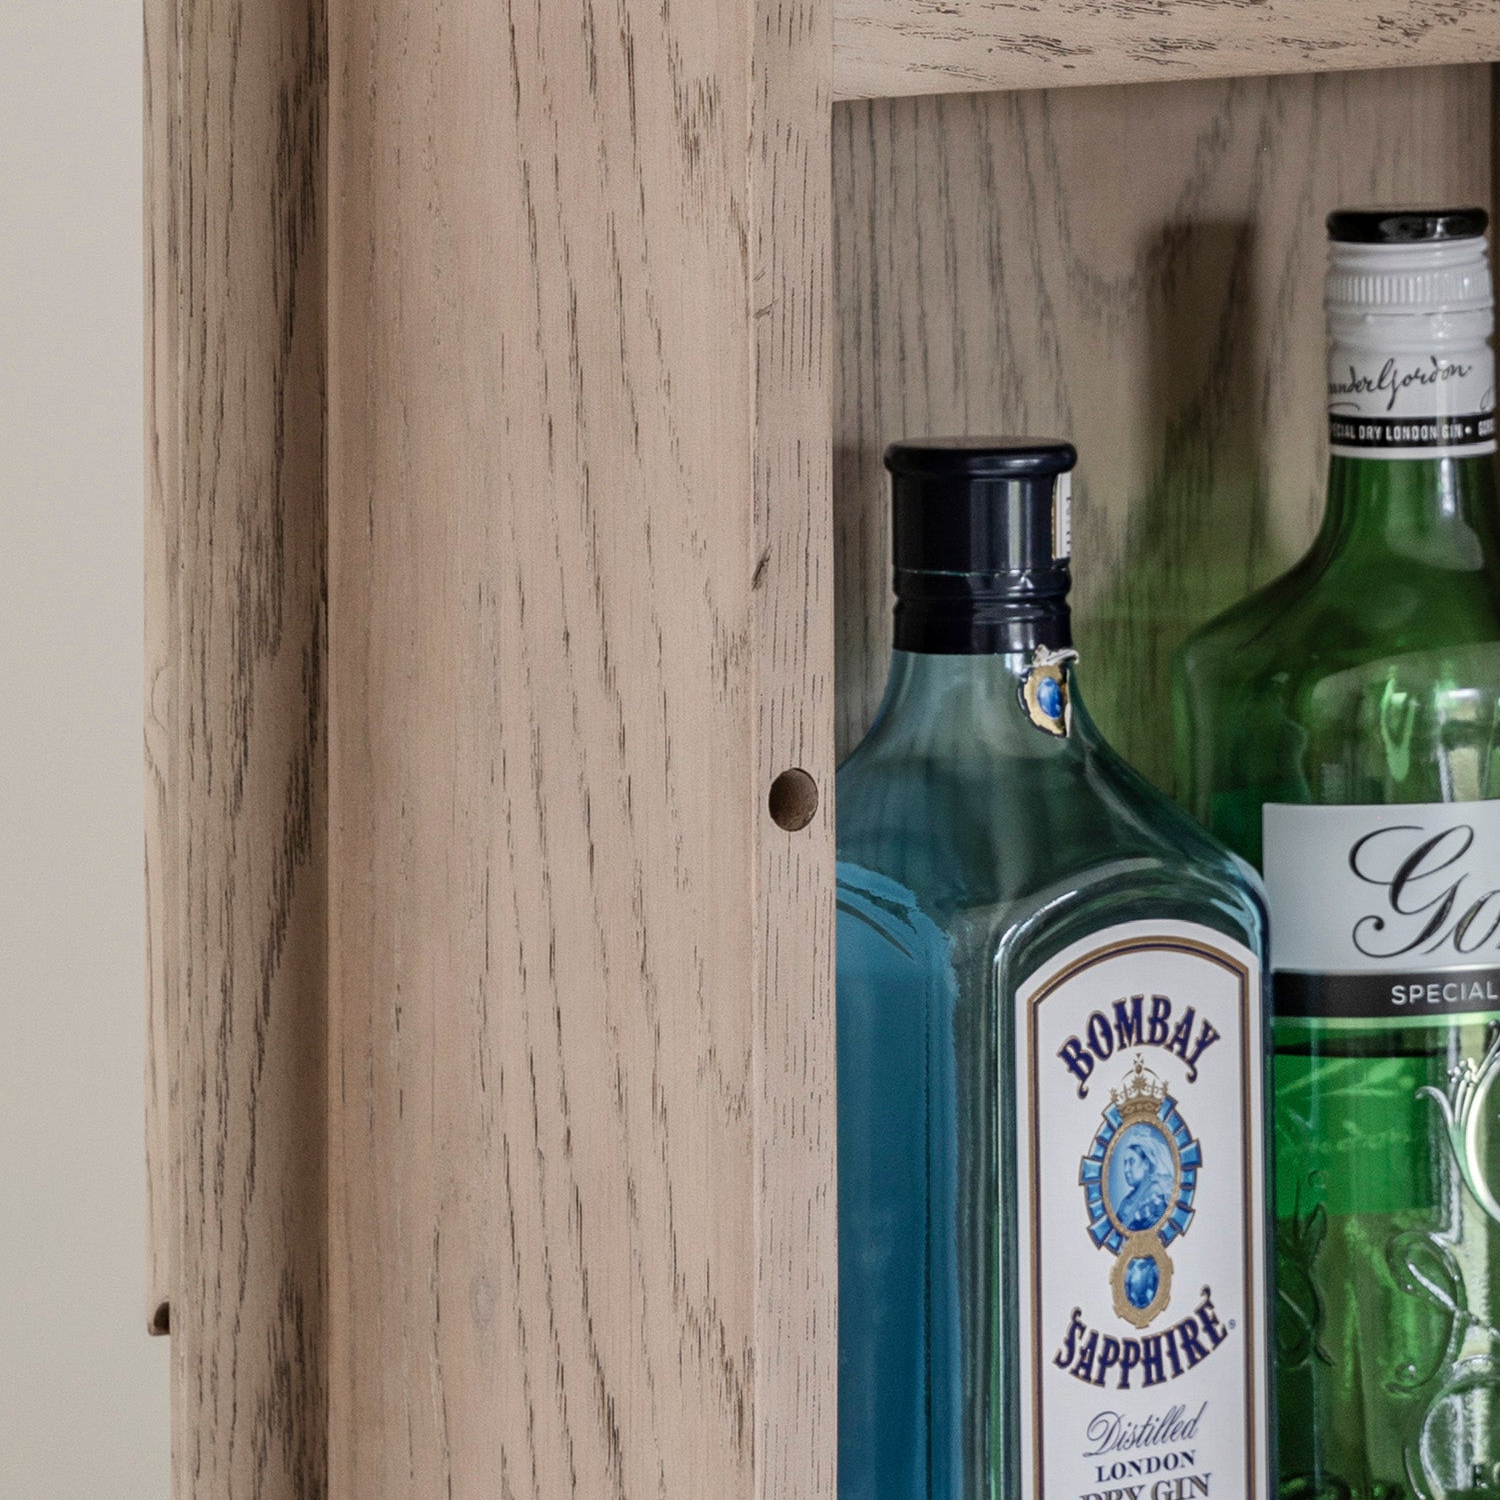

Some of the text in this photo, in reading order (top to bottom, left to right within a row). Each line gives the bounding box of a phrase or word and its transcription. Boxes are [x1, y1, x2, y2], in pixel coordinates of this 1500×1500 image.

[1358, 425, 1382, 440] DRY
[1386, 425, 1438, 441] LONDON
[1441, 423, 1464, 439] GIN
[1390, 980, 1499, 1005] SPECIAL
[1056, 994, 1221, 1099] BOMBAY
[1052, 1284, 1228, 1389] SAPPHIRE
[1082, 1400, 1208, 1457] Distilled
[1095, 1449, 1196, 1483] LONDON
[1150, 1472, 1211, 1500] GIN
